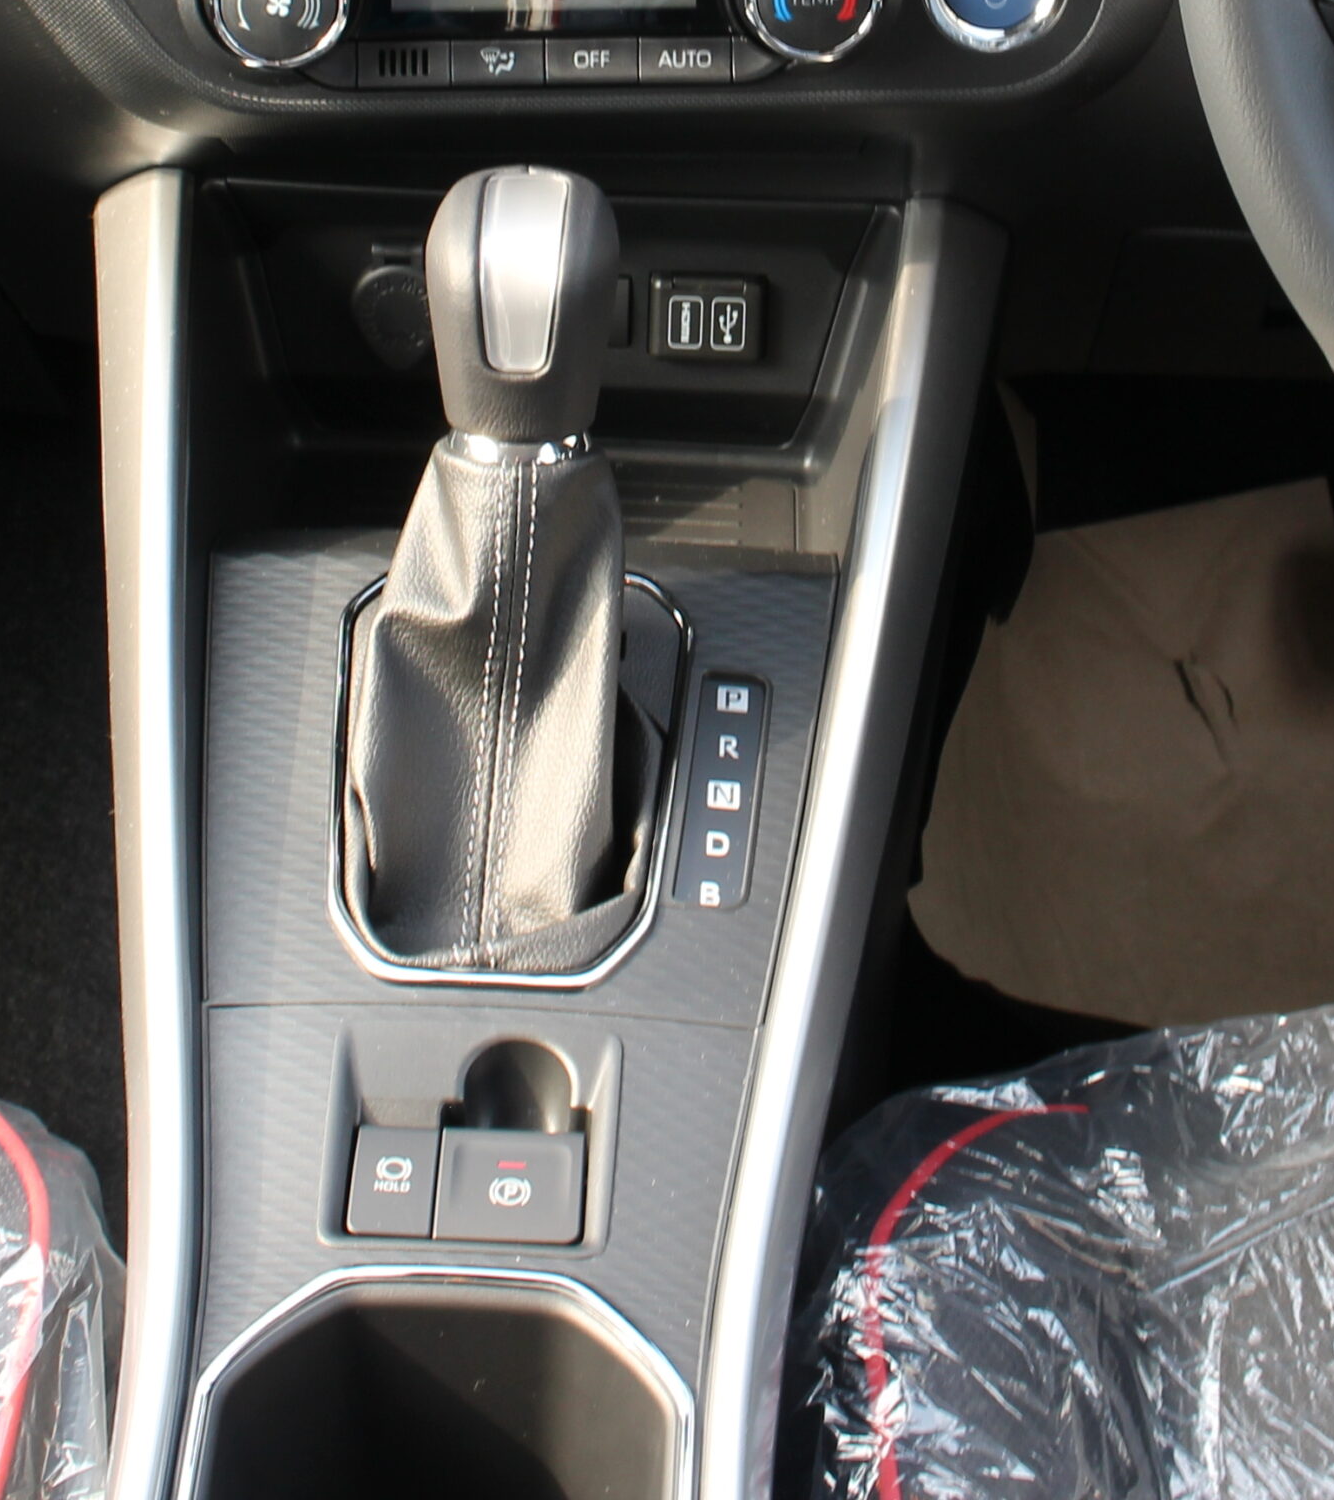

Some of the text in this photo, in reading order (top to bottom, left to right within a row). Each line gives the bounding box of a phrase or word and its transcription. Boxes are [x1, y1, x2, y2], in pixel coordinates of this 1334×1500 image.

[572, 49, 611, 70] OFF
[656, 49, 713, 70] AUTO
[719, 735, 739, 759] R
[705, 830, 730, 858] D
[699, 880, 721, 908] B
[373, 1180, 411, 1194] HOLD
